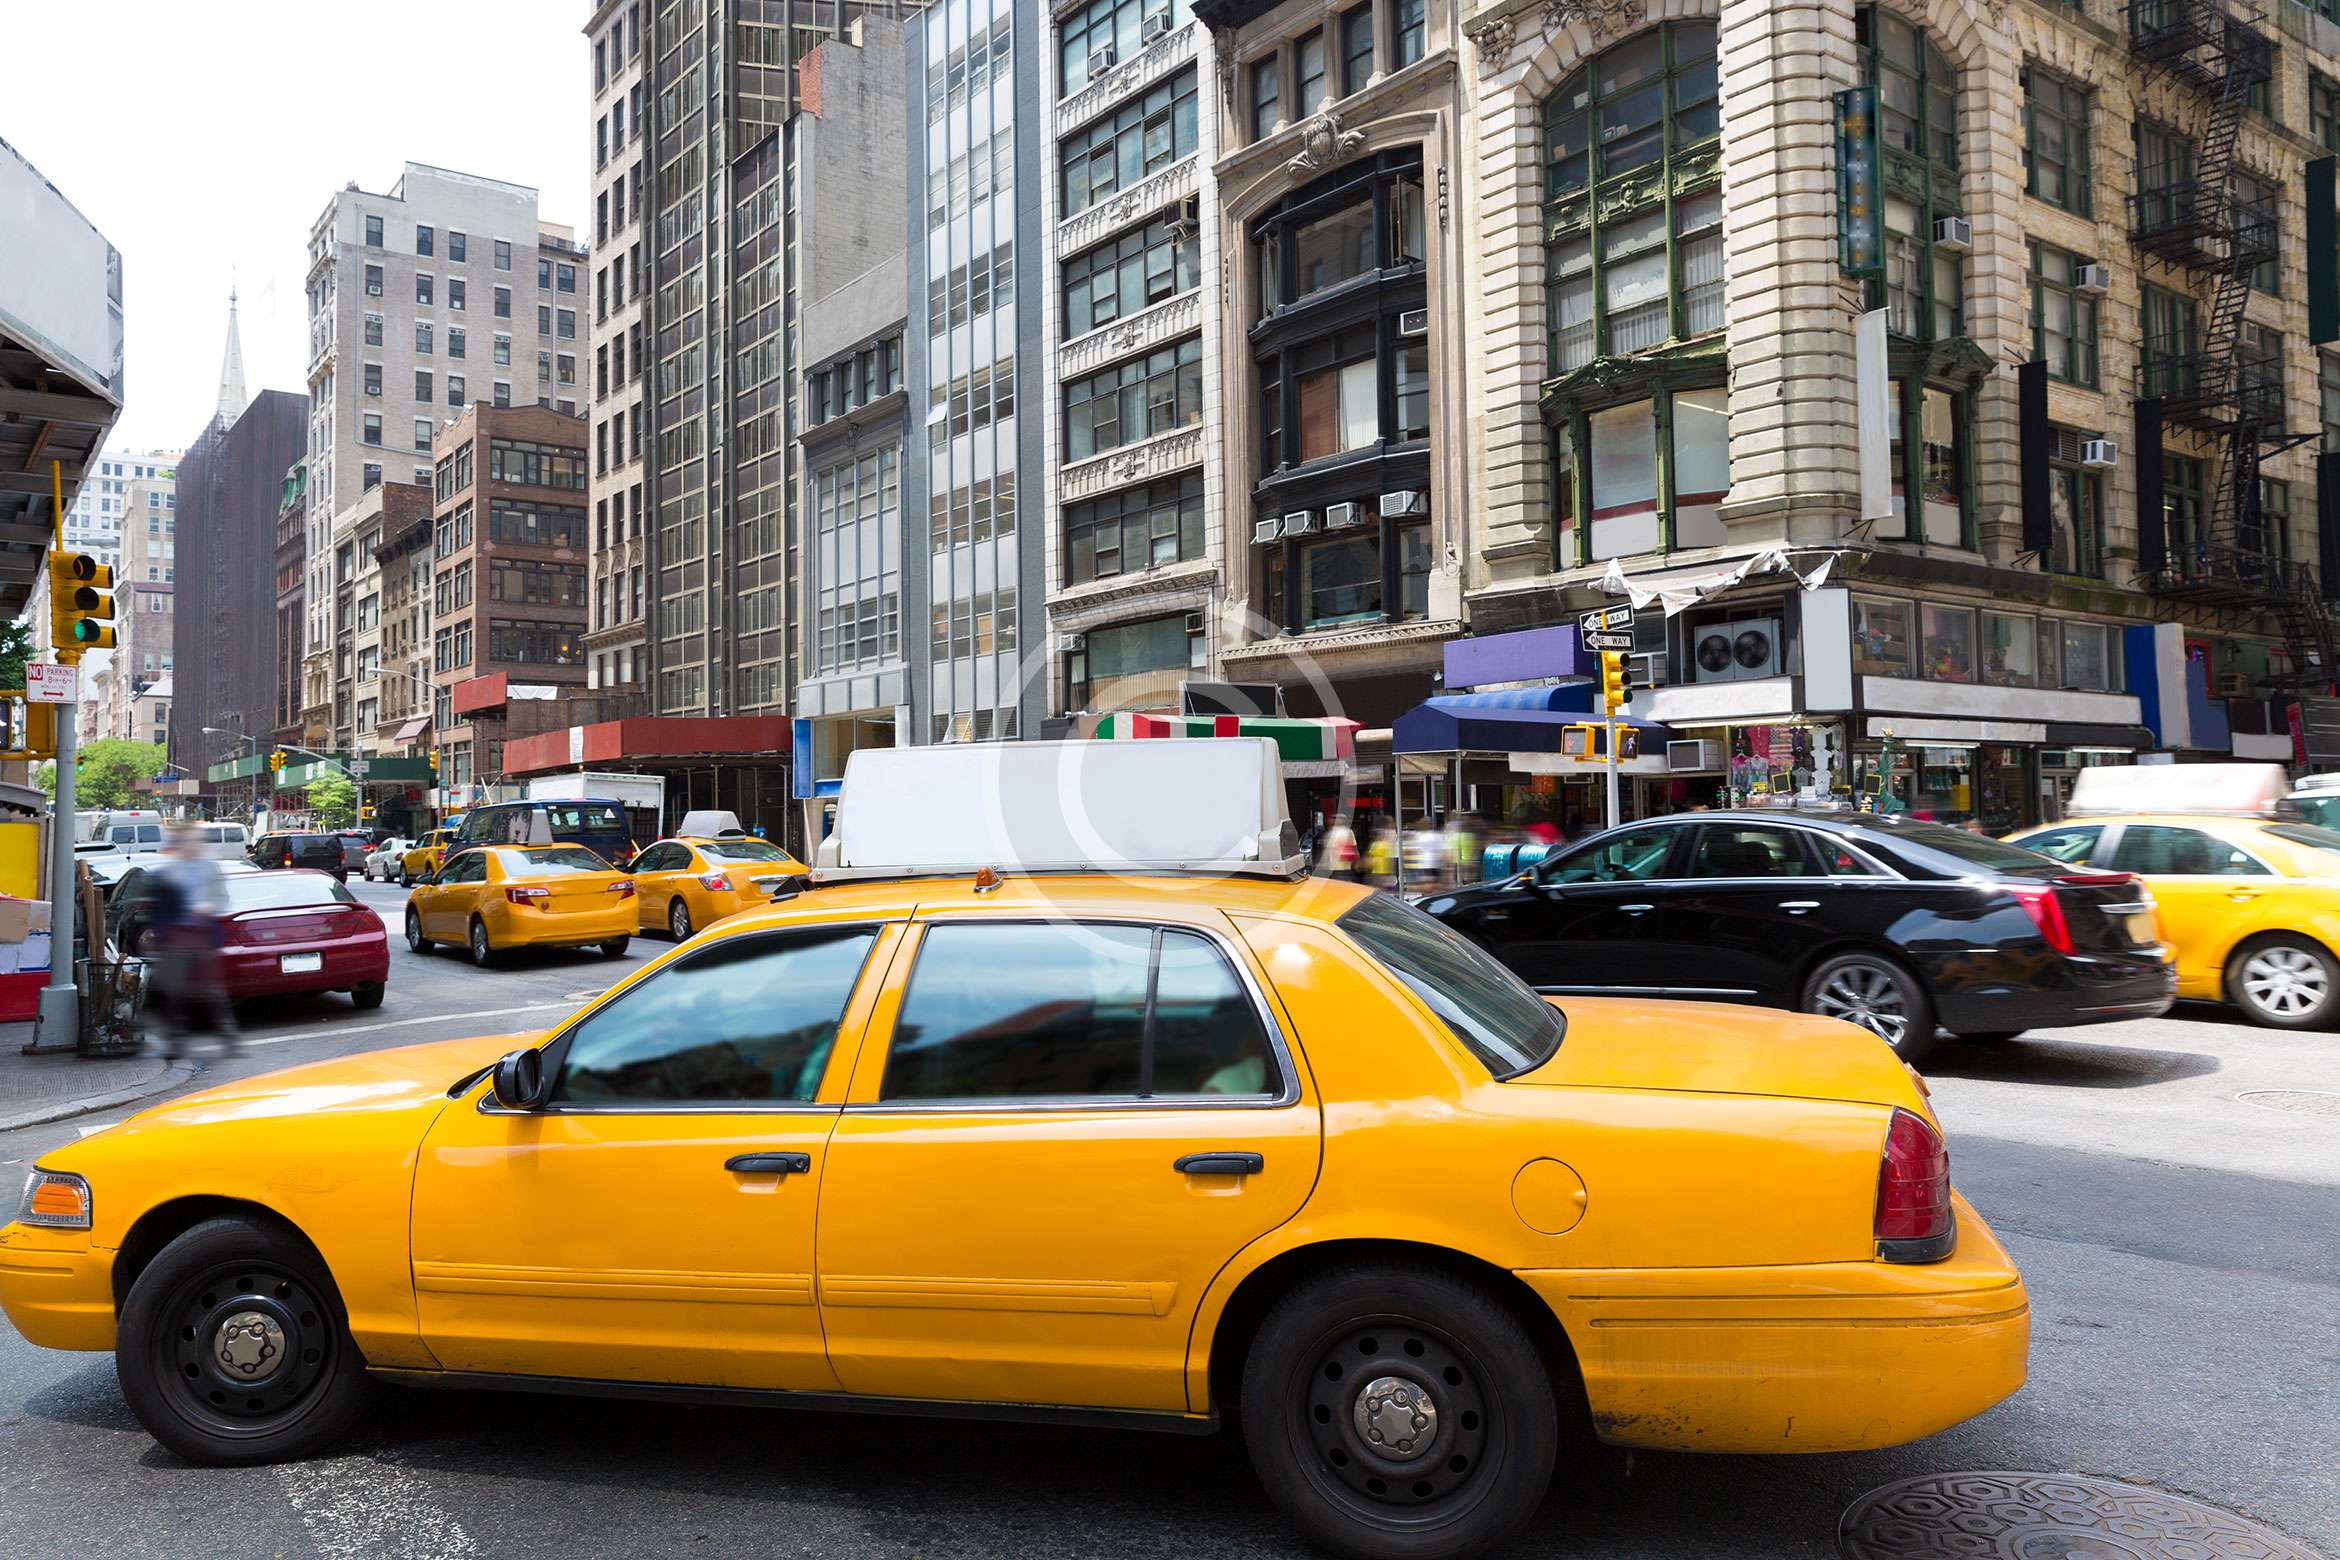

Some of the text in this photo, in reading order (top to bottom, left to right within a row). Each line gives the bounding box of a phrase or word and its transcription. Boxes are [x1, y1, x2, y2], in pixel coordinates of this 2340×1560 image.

[1589, 612, 1626, 628] ONE WAY
[1590, 636, 1627, 646] ONE WAY
[29, 665, 42, 679] NO
